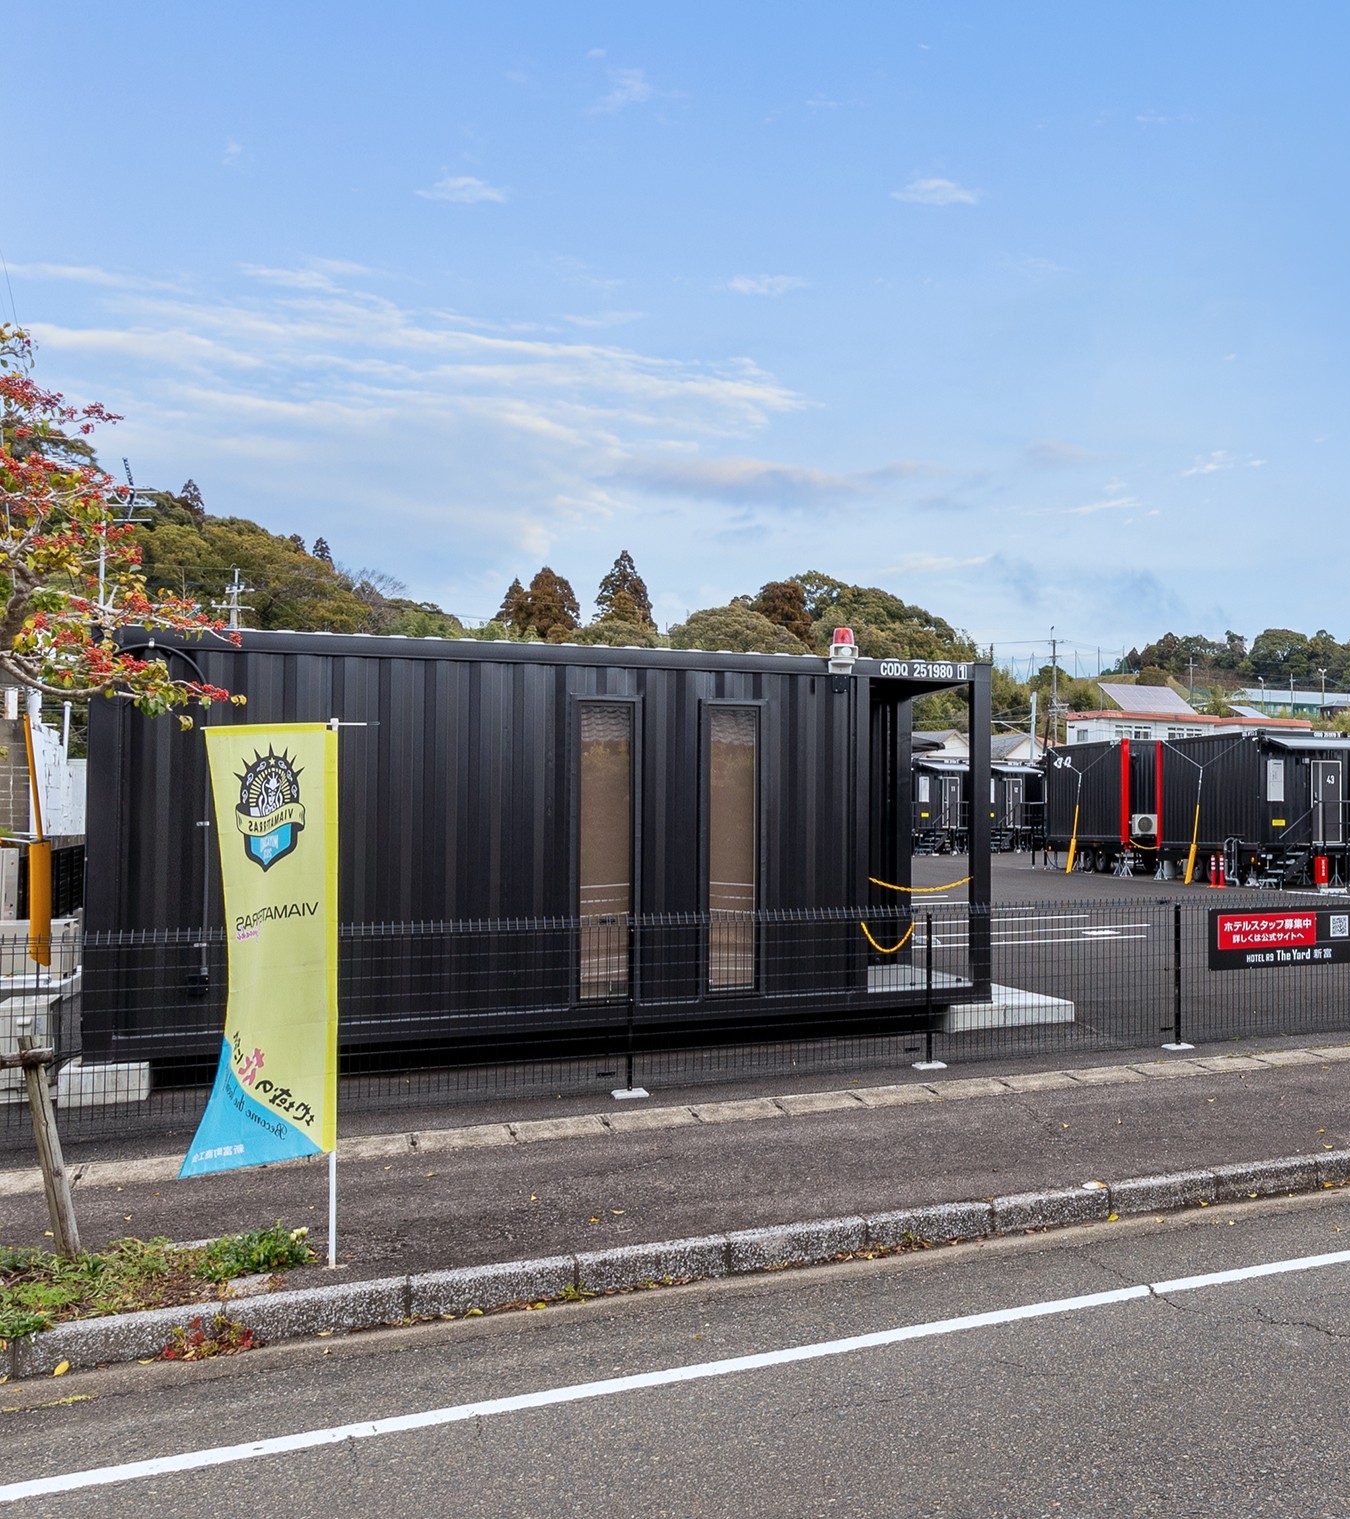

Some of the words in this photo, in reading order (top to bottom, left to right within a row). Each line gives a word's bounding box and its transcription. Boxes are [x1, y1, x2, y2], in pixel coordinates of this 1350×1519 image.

[880, 662, 909, 677] CODQ
[913, 664, 954, 679] 251980
[1326, 775, 1335, 785] 43
[1223, 918, 1313, 932] ホテルスタッフ募集中
[1232, 932, 1305, 944] 詳しくは公式サイトへ
[1246, 954, 1266, 963] HOTEL
[1276, 950, 1291, 961] The
[1292, 949, 1311, 960] Yard
[1313, 948, 1332, 959] 新富
